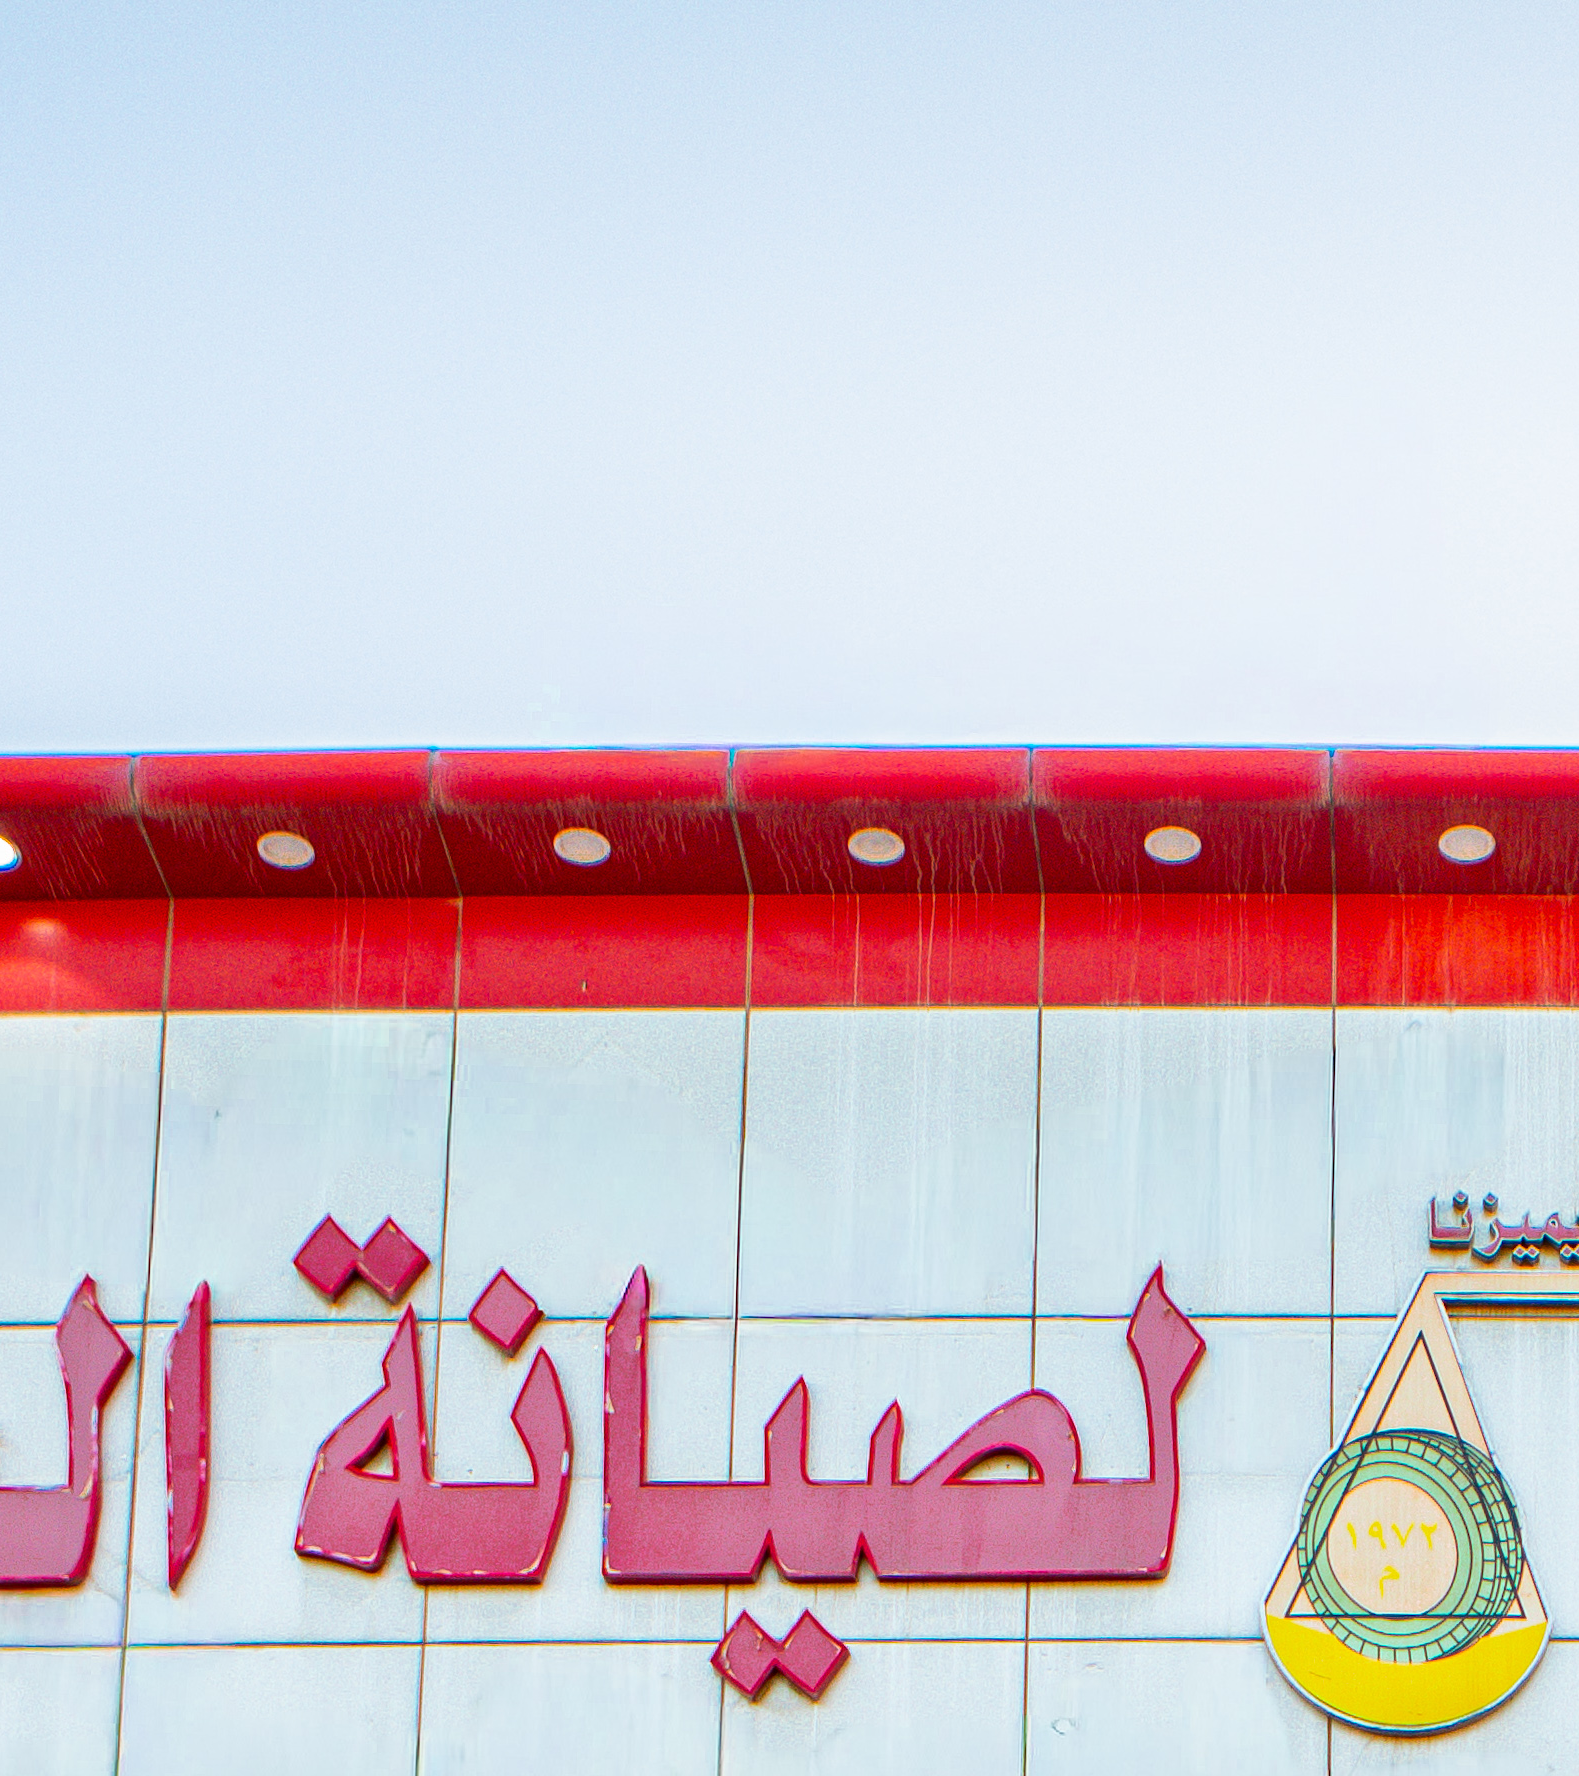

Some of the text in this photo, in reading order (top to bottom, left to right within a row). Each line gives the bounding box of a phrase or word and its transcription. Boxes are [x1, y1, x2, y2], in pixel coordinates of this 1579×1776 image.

[293, 1216, 1208, 1701] لصيانة
[1345, 1519, 1439, 1552] ١٩٧٢
[1376, 1566, 1402, 1597] م
